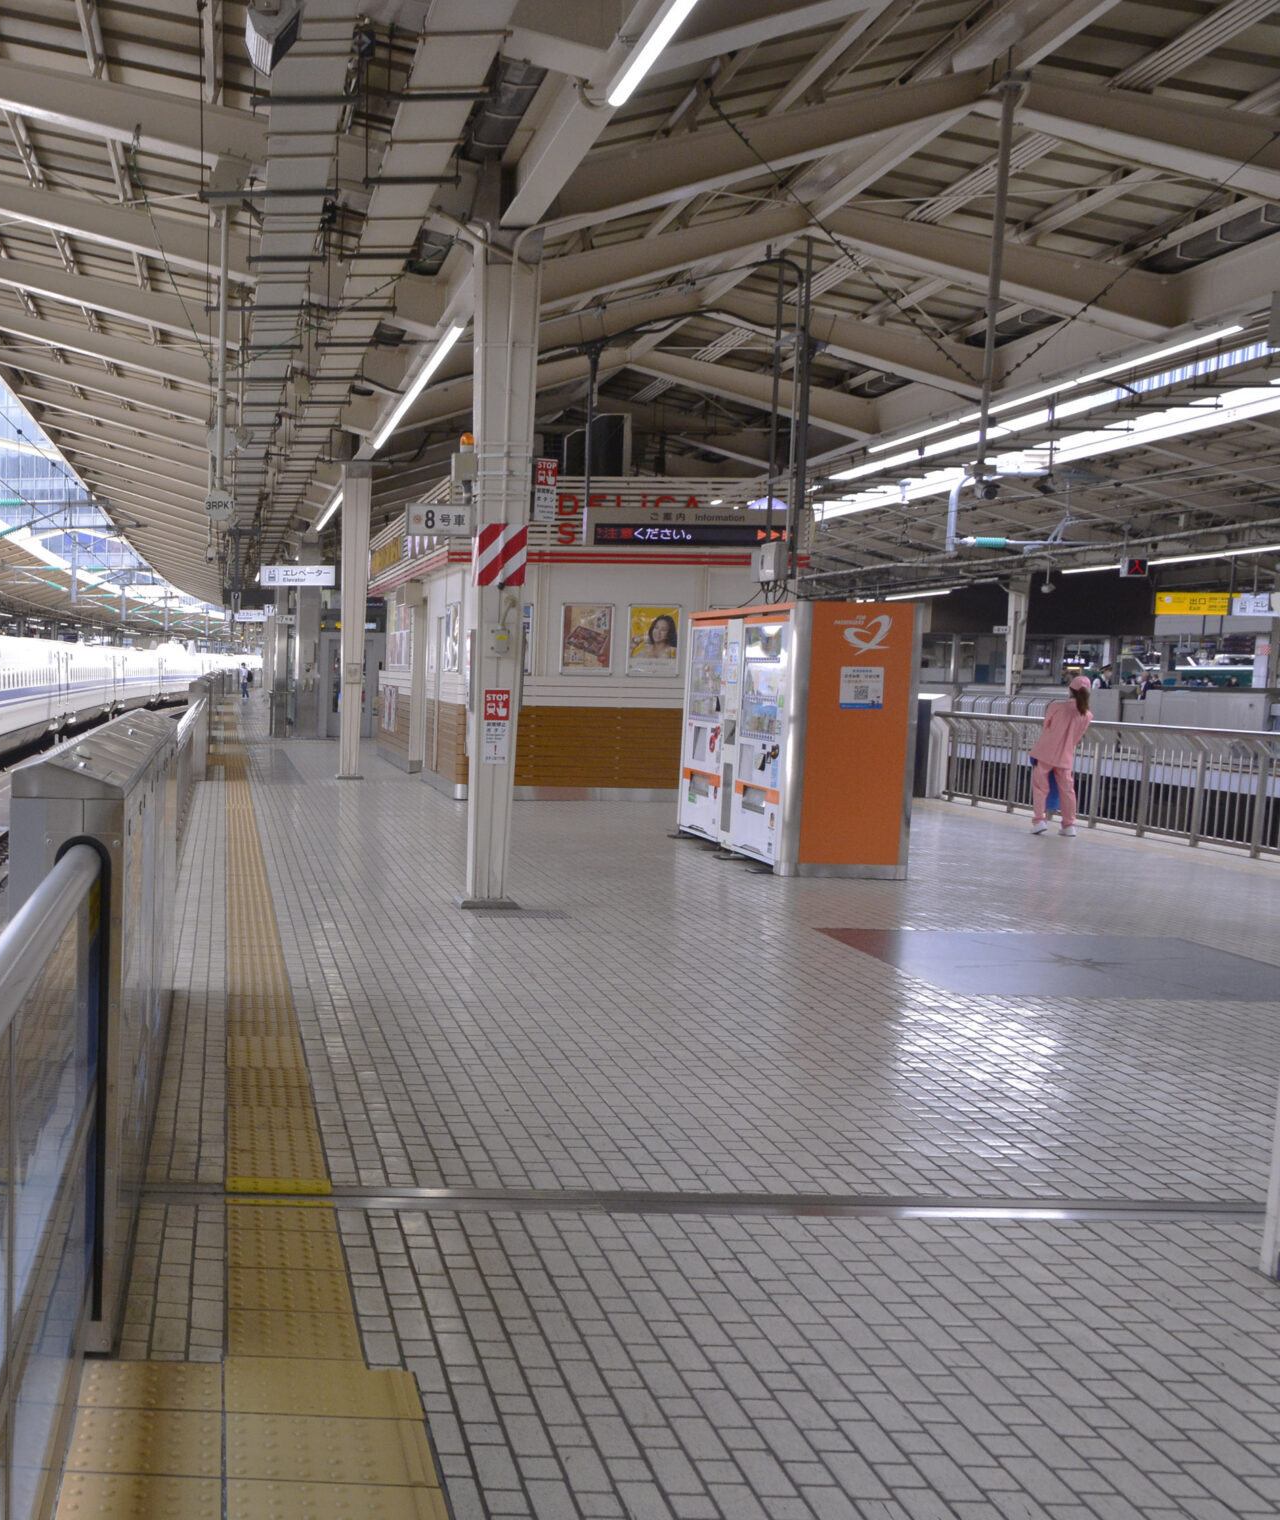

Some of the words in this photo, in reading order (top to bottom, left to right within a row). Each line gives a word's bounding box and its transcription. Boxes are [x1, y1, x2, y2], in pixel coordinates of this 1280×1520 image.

[538, 461, 557, 469] STOP
[205, 501, 234, 510] 3RPK1
[695, 513, 746, 522] Information
[282, 569, 331, 577] エレベーター
[1189, 597, 1207, 605] 出口
[486, 693, 508, 701] STOP
